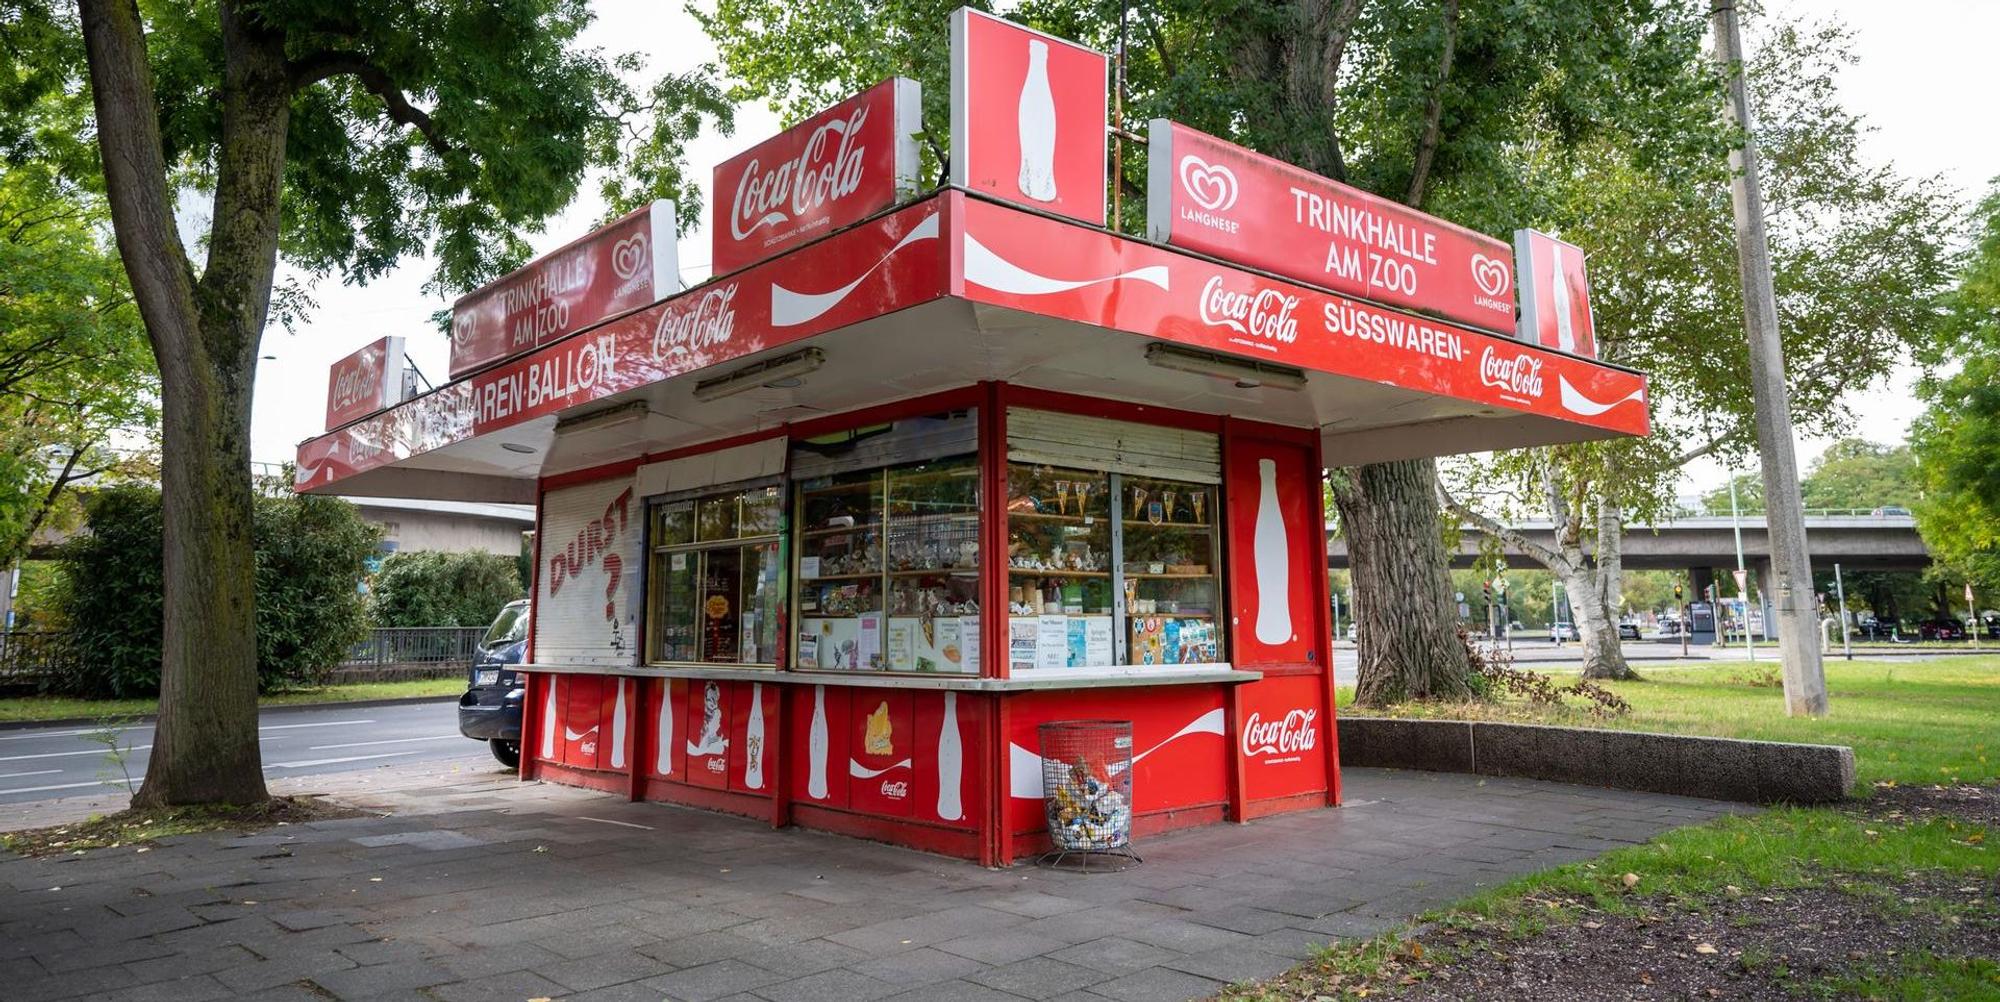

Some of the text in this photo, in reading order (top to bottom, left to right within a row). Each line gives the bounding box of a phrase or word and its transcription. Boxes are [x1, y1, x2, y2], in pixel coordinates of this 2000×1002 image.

[730, 103, 871, 241] Coca-Cola
[1181, 205, 1238, 234] LANGNESE
[1290, 187, 1438, 265] TRINKHALLE
[500, 256, 586, 316] TRINKHALLE
[1325, 240, 1417, 296] AM ZOO
[512, 300, 570, 348] AM ZOO
[654, 282, 739, 362] Coca-Cola
[1199, 274, 1302, 344] Coca-Cola
[1323, 299, 1471, 362] SÜSSWAREN-
[1473, 294, 1511, 314] LANGNESE
[1480, 345, 1544, 398] Coca-Cola
[550, 486, 633, 598] DURST
[1242, 708, 1317, 757] Coca-Cola
